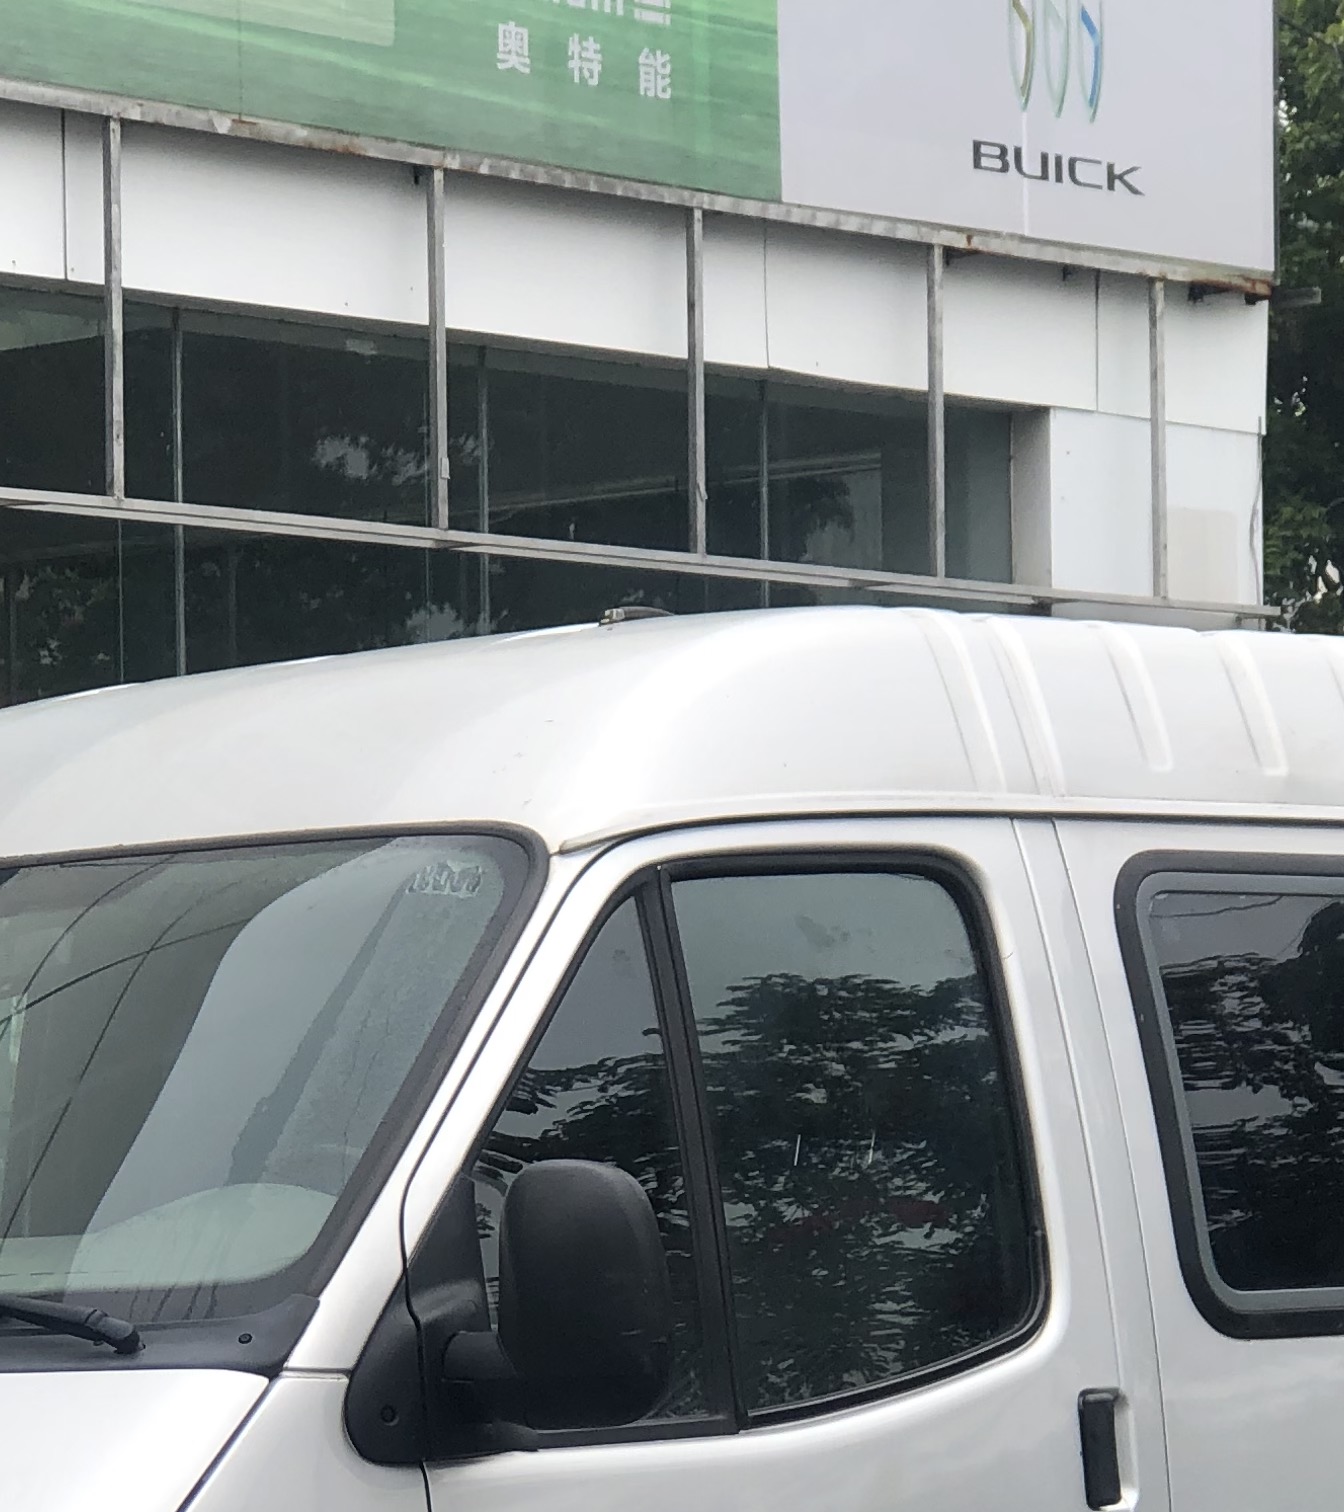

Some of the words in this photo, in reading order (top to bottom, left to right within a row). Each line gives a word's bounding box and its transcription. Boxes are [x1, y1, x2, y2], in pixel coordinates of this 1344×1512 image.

[496, 21, 672, 99] 奥特能
[972, 139, 1146, 196] BUICK
